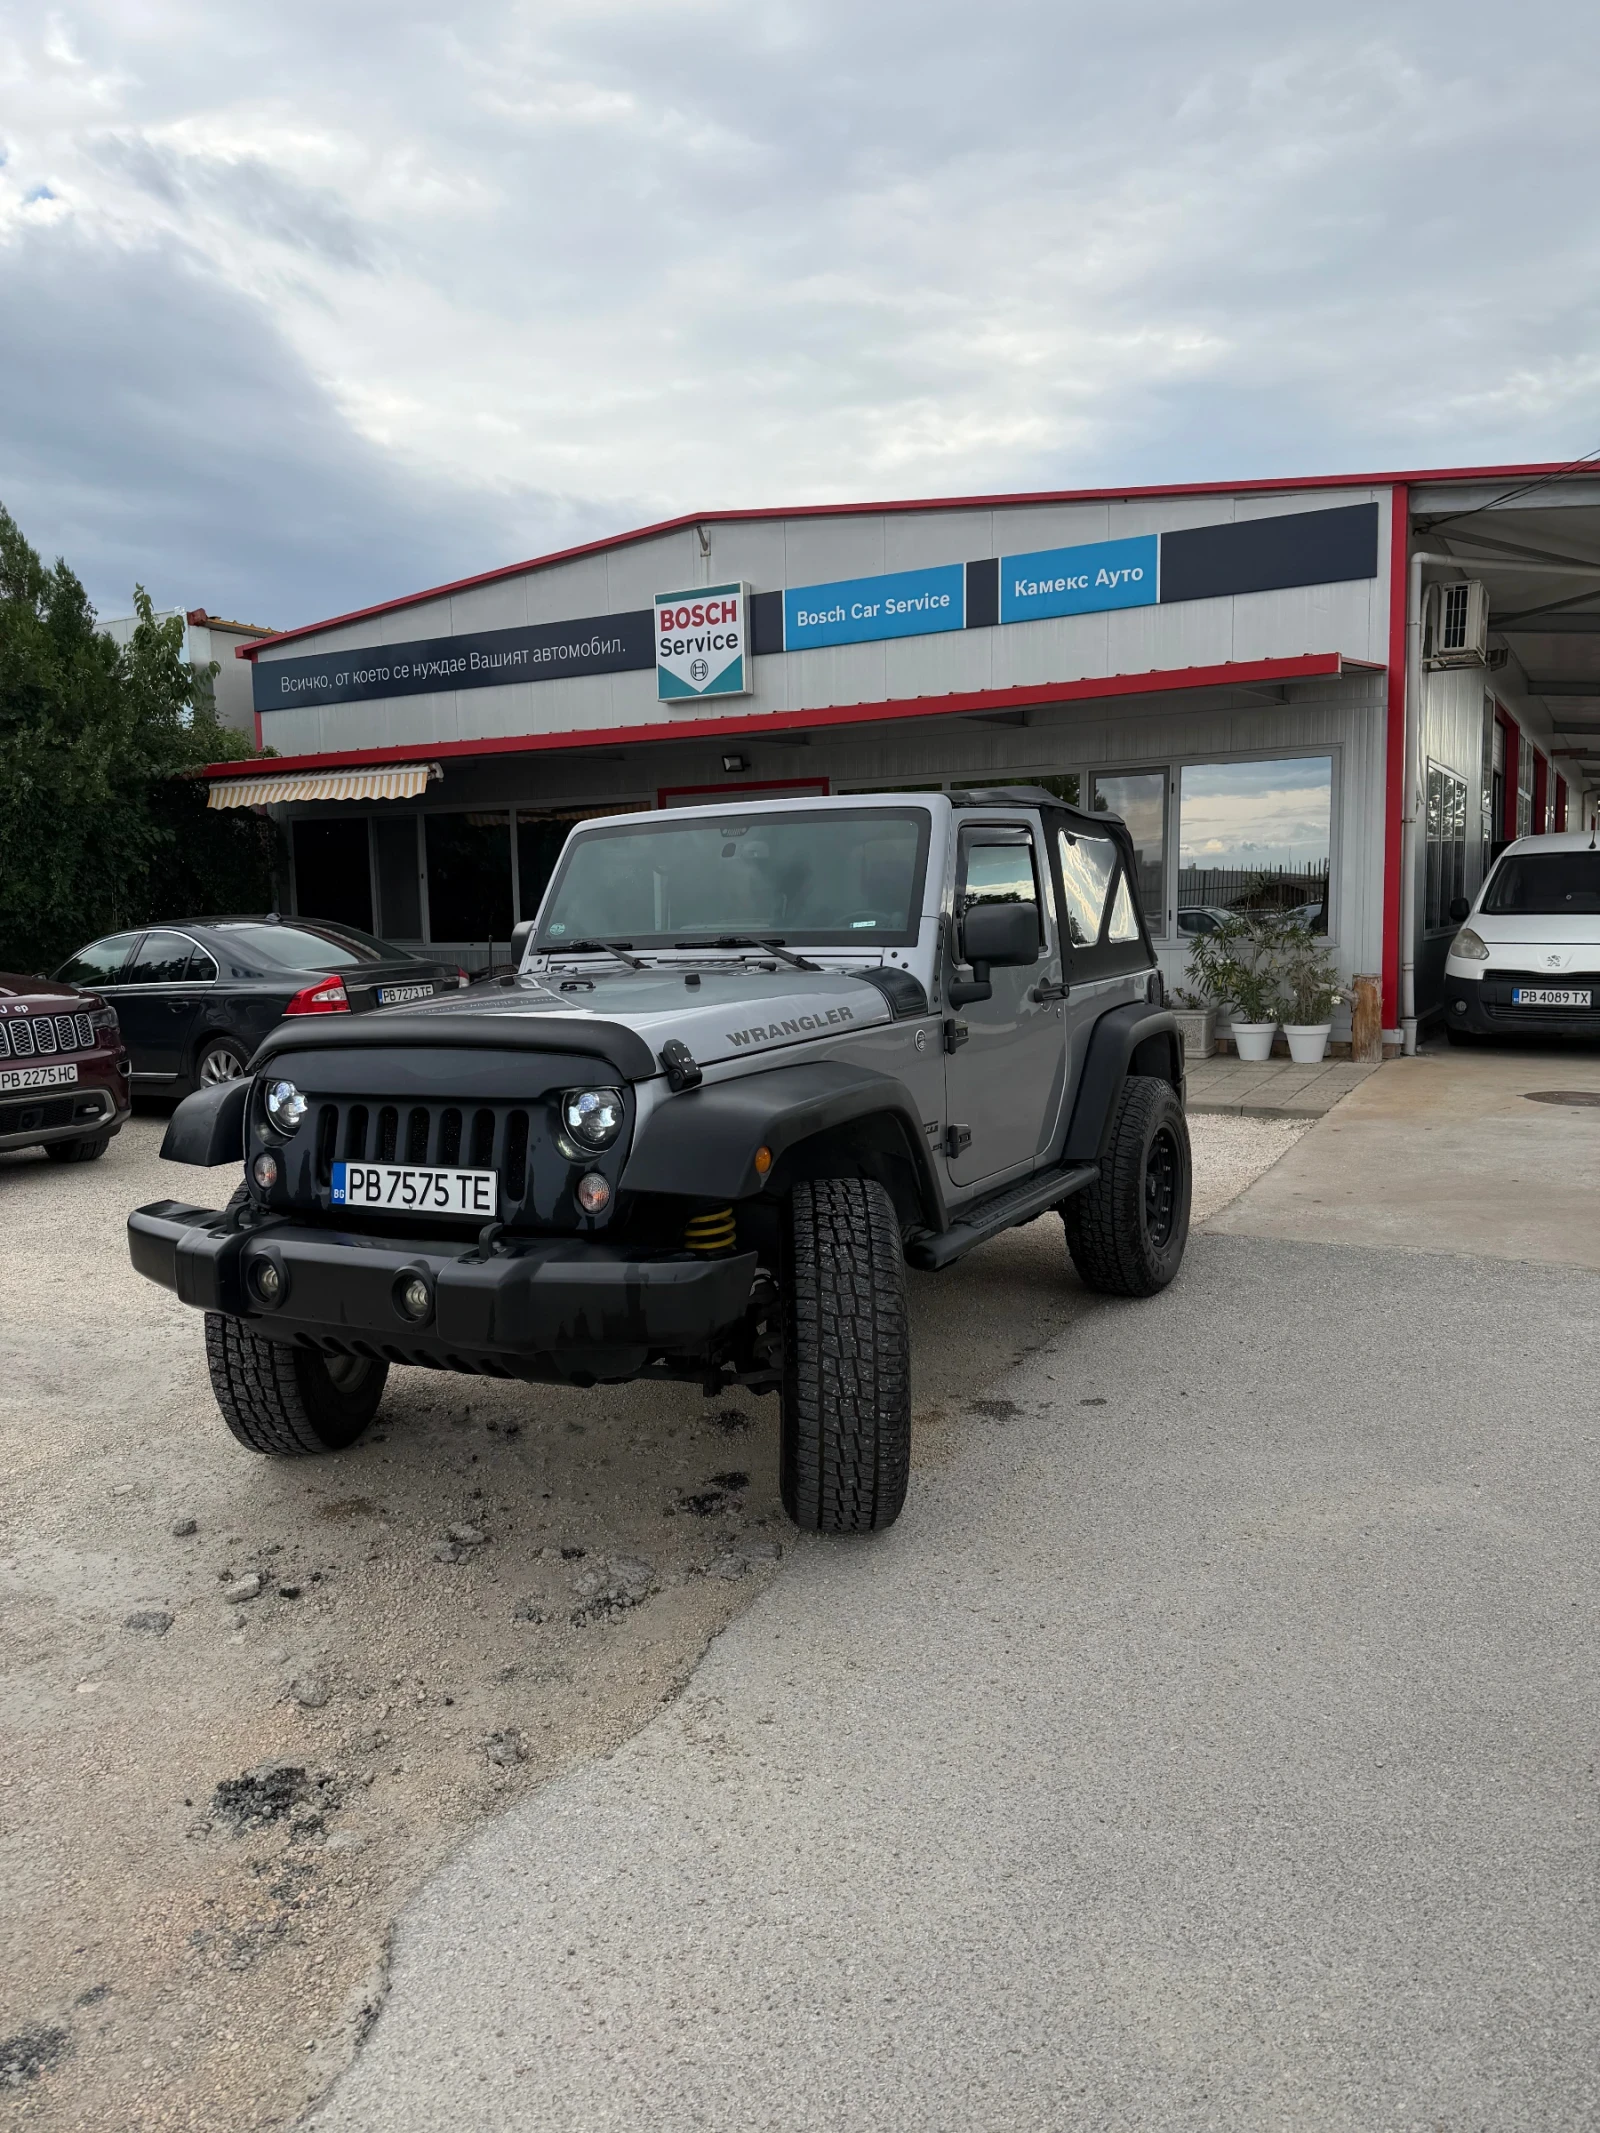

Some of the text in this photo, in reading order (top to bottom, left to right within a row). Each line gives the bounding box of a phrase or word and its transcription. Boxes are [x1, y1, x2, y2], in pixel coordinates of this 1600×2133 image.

[1015, 567, 1144, 597] Камекс Ауто
[660, 600, 737, 632] BOSCH
[797, 592, 950, 627] Bosch Car Service
[660, 630, 738, 657] Service
[281, 636, 626, 693] Всичко, от което се нуждае Вашият автомобил.
[1521, 990, 1537, 1003] PB
[1540, 991, 1570, 1003] 4089
[1572, 992, 1589, 1004] TX
[725, 1006, 855, 1047] WRANGLER
[1, 1066, 76, 1089] PB 2275 HC
[333, 1188, 345, 1199] BG
[349, 1168, 491, 1211] PB 7575 TE
